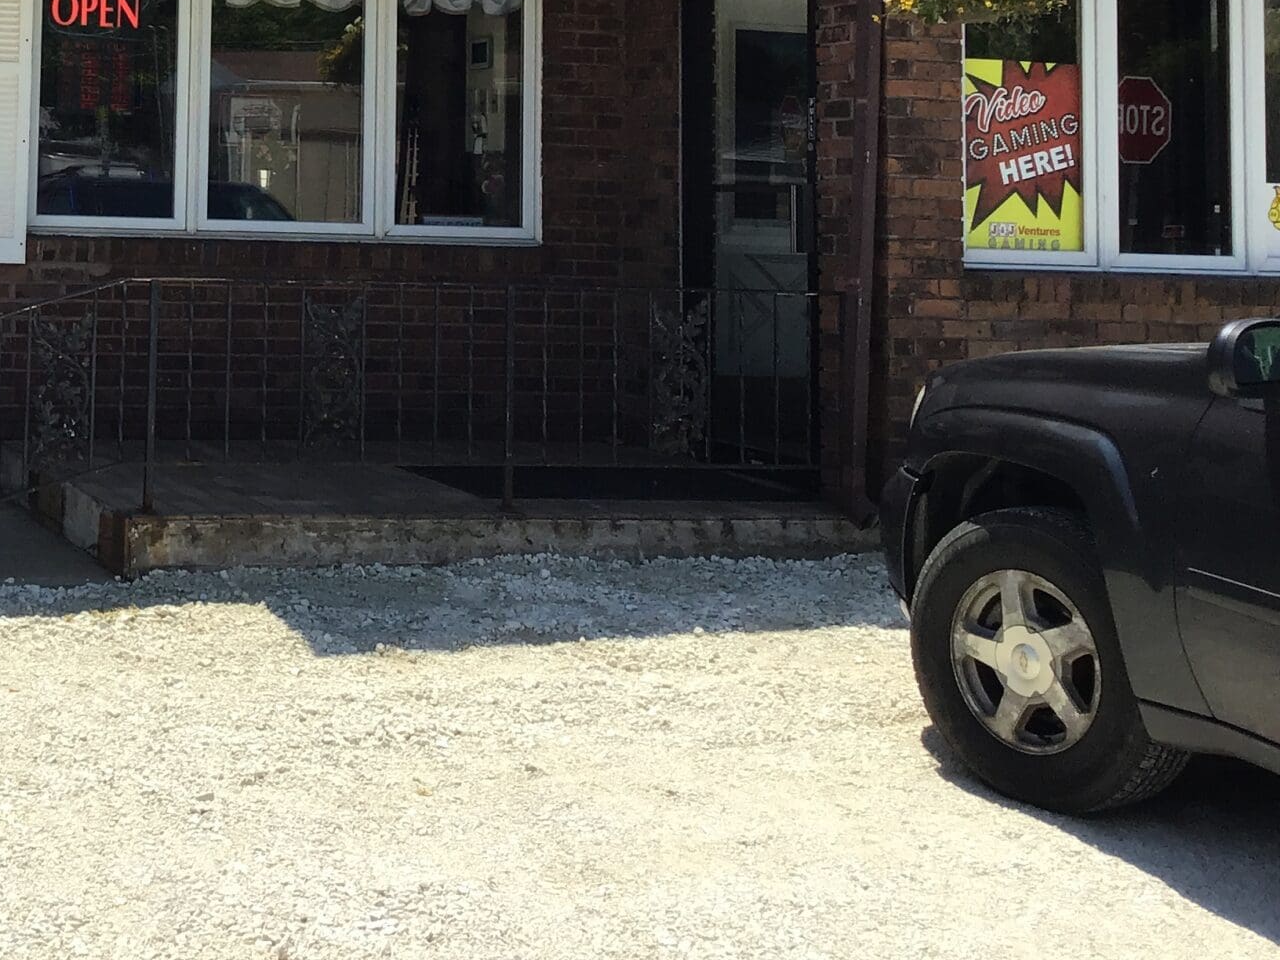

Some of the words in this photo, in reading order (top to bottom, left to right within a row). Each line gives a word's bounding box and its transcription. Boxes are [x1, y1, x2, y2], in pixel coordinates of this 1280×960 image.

[965, 86, 1046, 132] Video
[969, 114, 1079, 160] GAMING
[999, 144, 1075, 185] HERE!
[1018, 226, 1061, 236] Ventures
